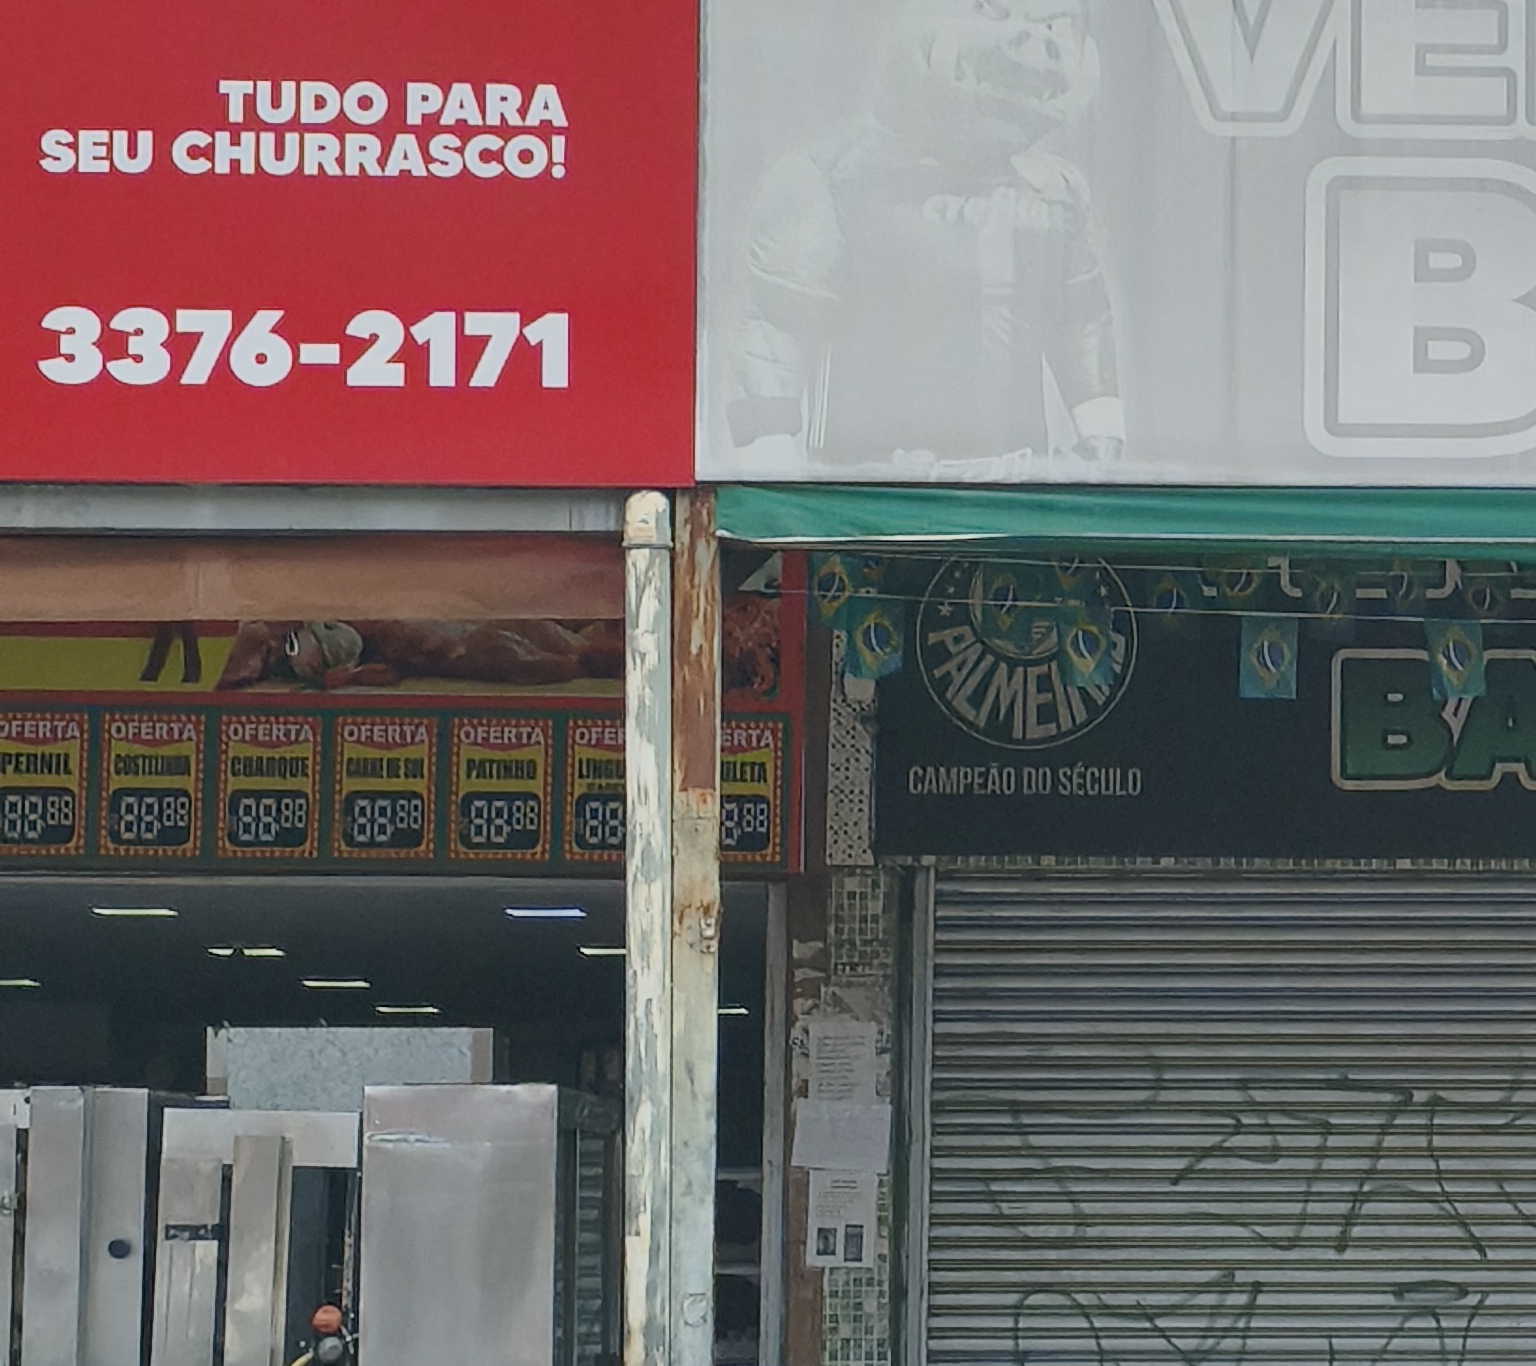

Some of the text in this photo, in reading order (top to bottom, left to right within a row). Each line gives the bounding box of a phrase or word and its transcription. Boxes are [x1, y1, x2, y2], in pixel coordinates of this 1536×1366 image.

[219, 81, 569, 129] TUDO PARA
[39, 128, 567, 178] SEU CHURRASCO!
[37, 306, 570, 390] 3376-2171
[110, 722, 197, 741] OFERTA
[228, 723, 314, 743] OFERTA
[343, 724, 429, 744] OFERTA
[460, 726, 546, 745] OFERTA
[907, 761, 1142, 797] CAMPEÃO DO SÉCULO
